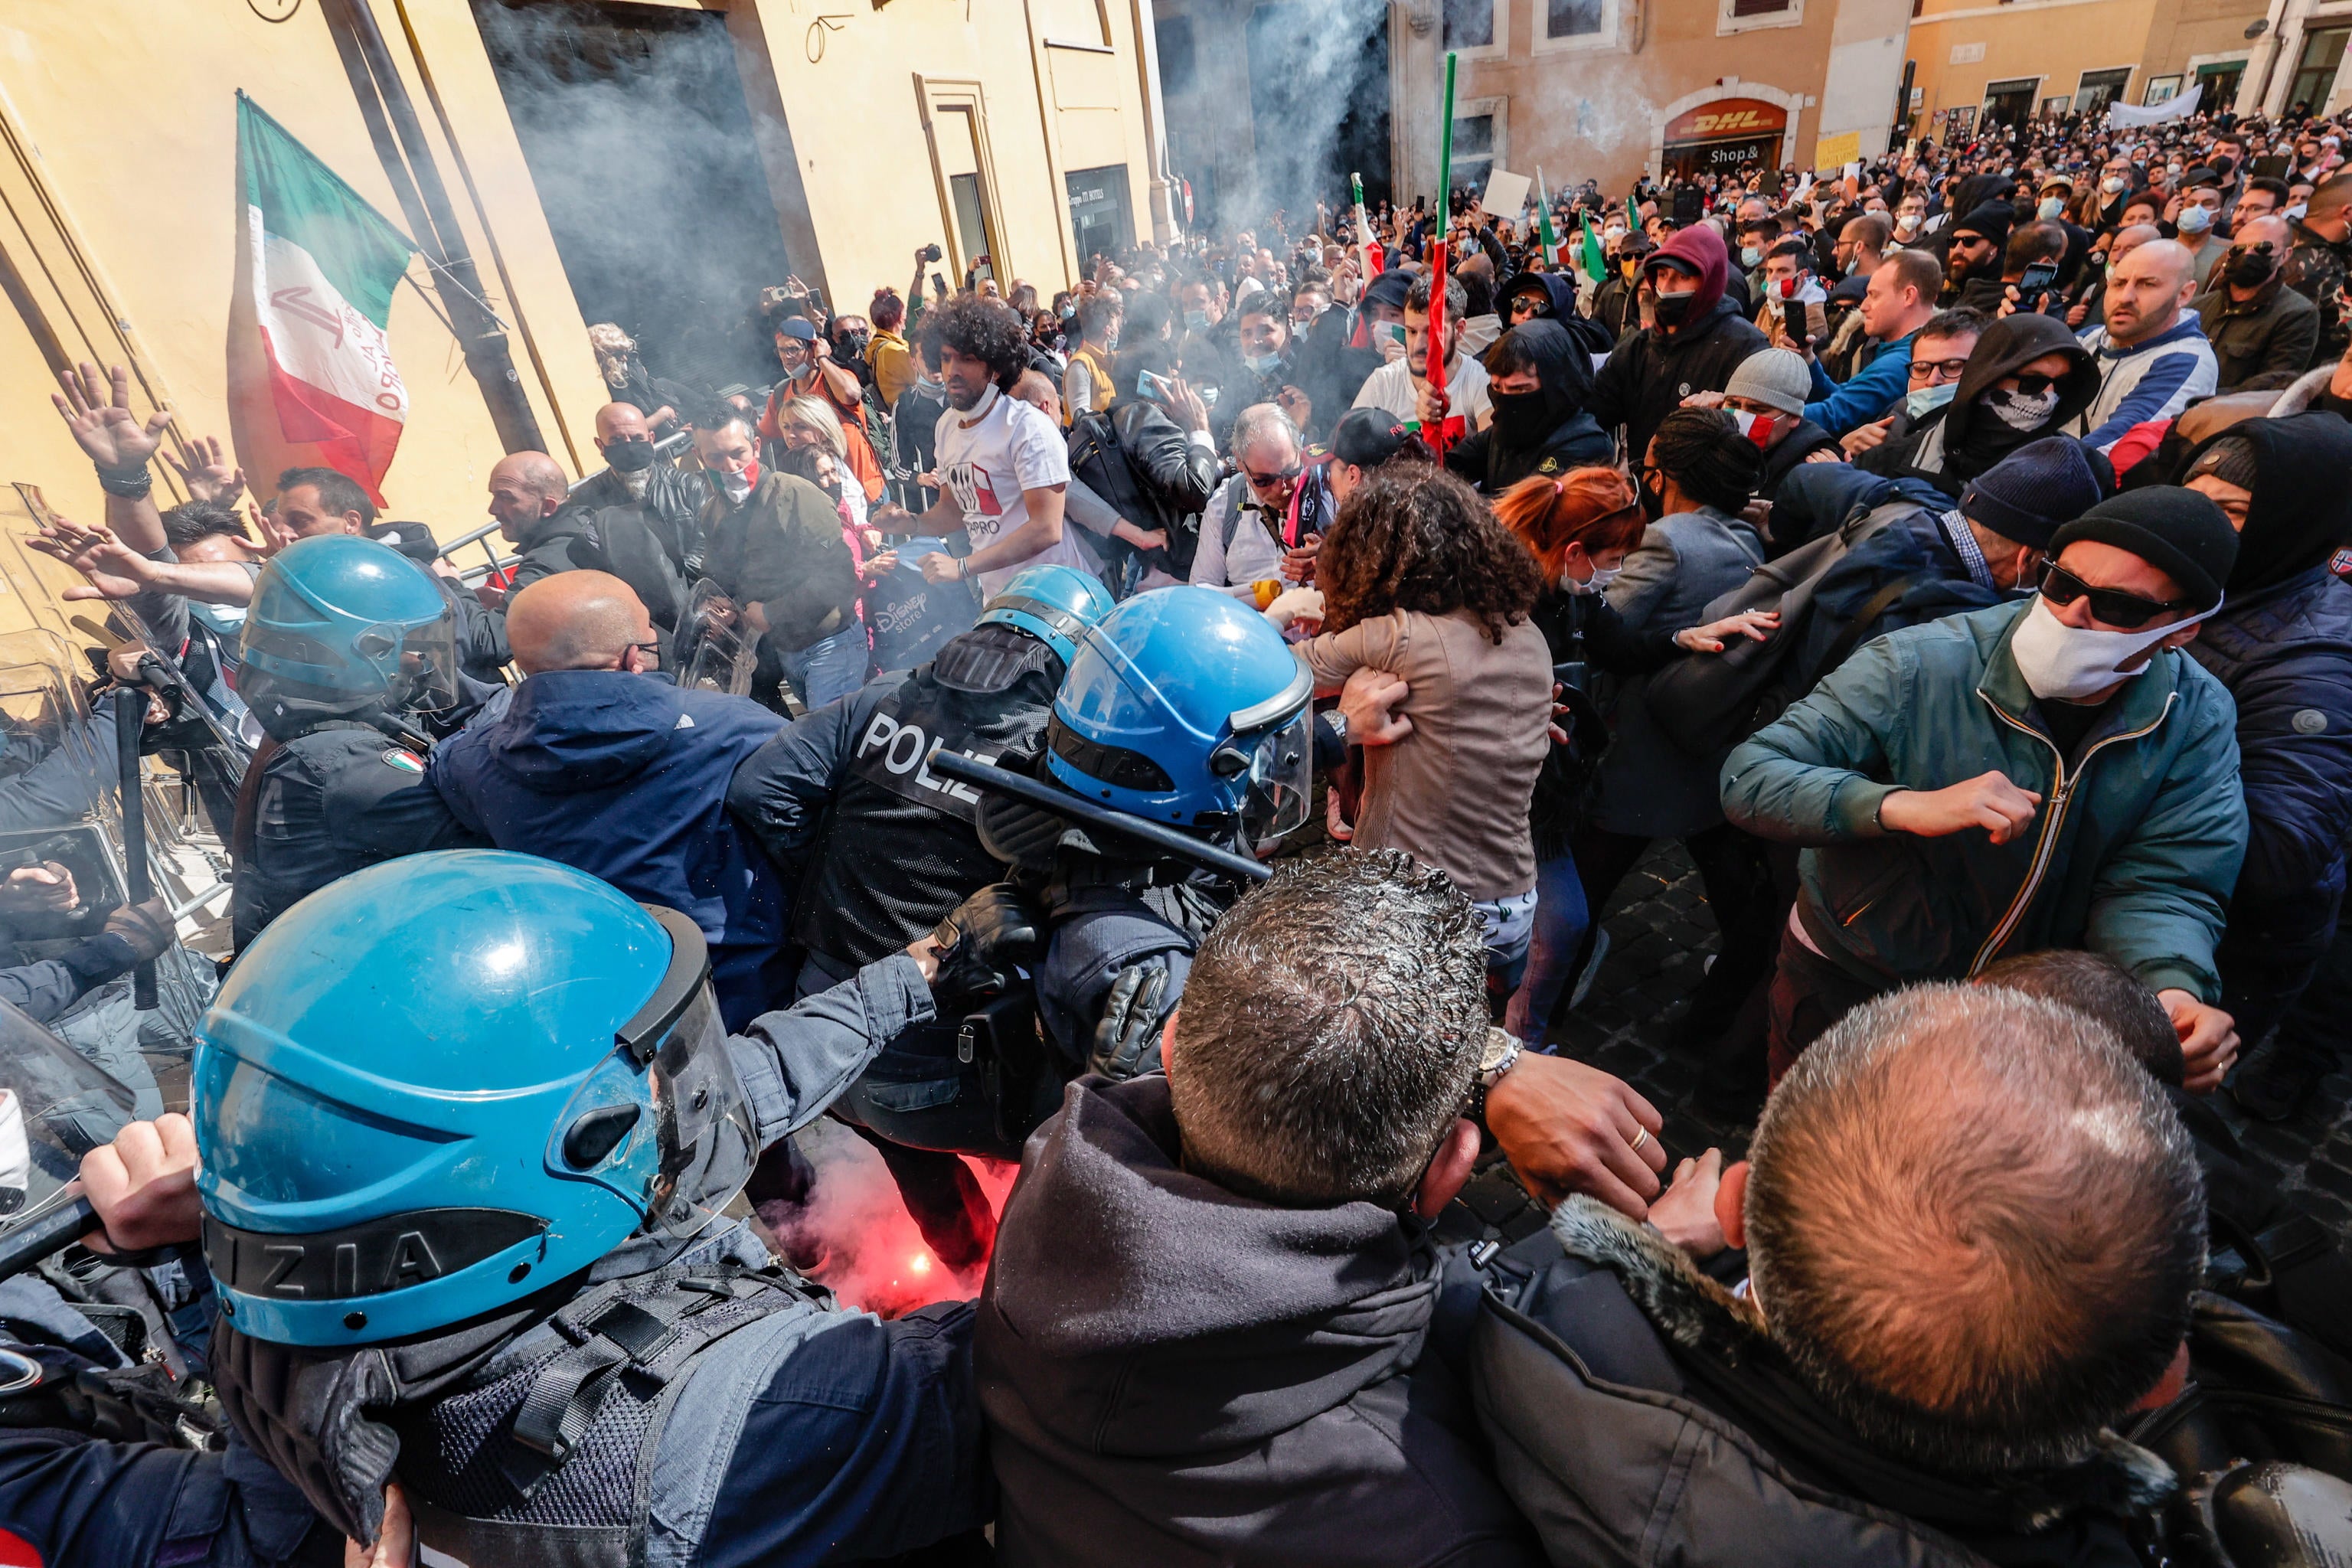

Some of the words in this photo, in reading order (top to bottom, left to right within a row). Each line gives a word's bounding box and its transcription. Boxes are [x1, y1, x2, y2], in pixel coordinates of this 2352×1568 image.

[1692, 109, 1760, 133] DHL
[1710, 148, 1746, 164] Shop
[1747, 145, 1759, 159] &
[1089, 188, 1104, 201] HOTELS
[895, 610, 922, 634] store
